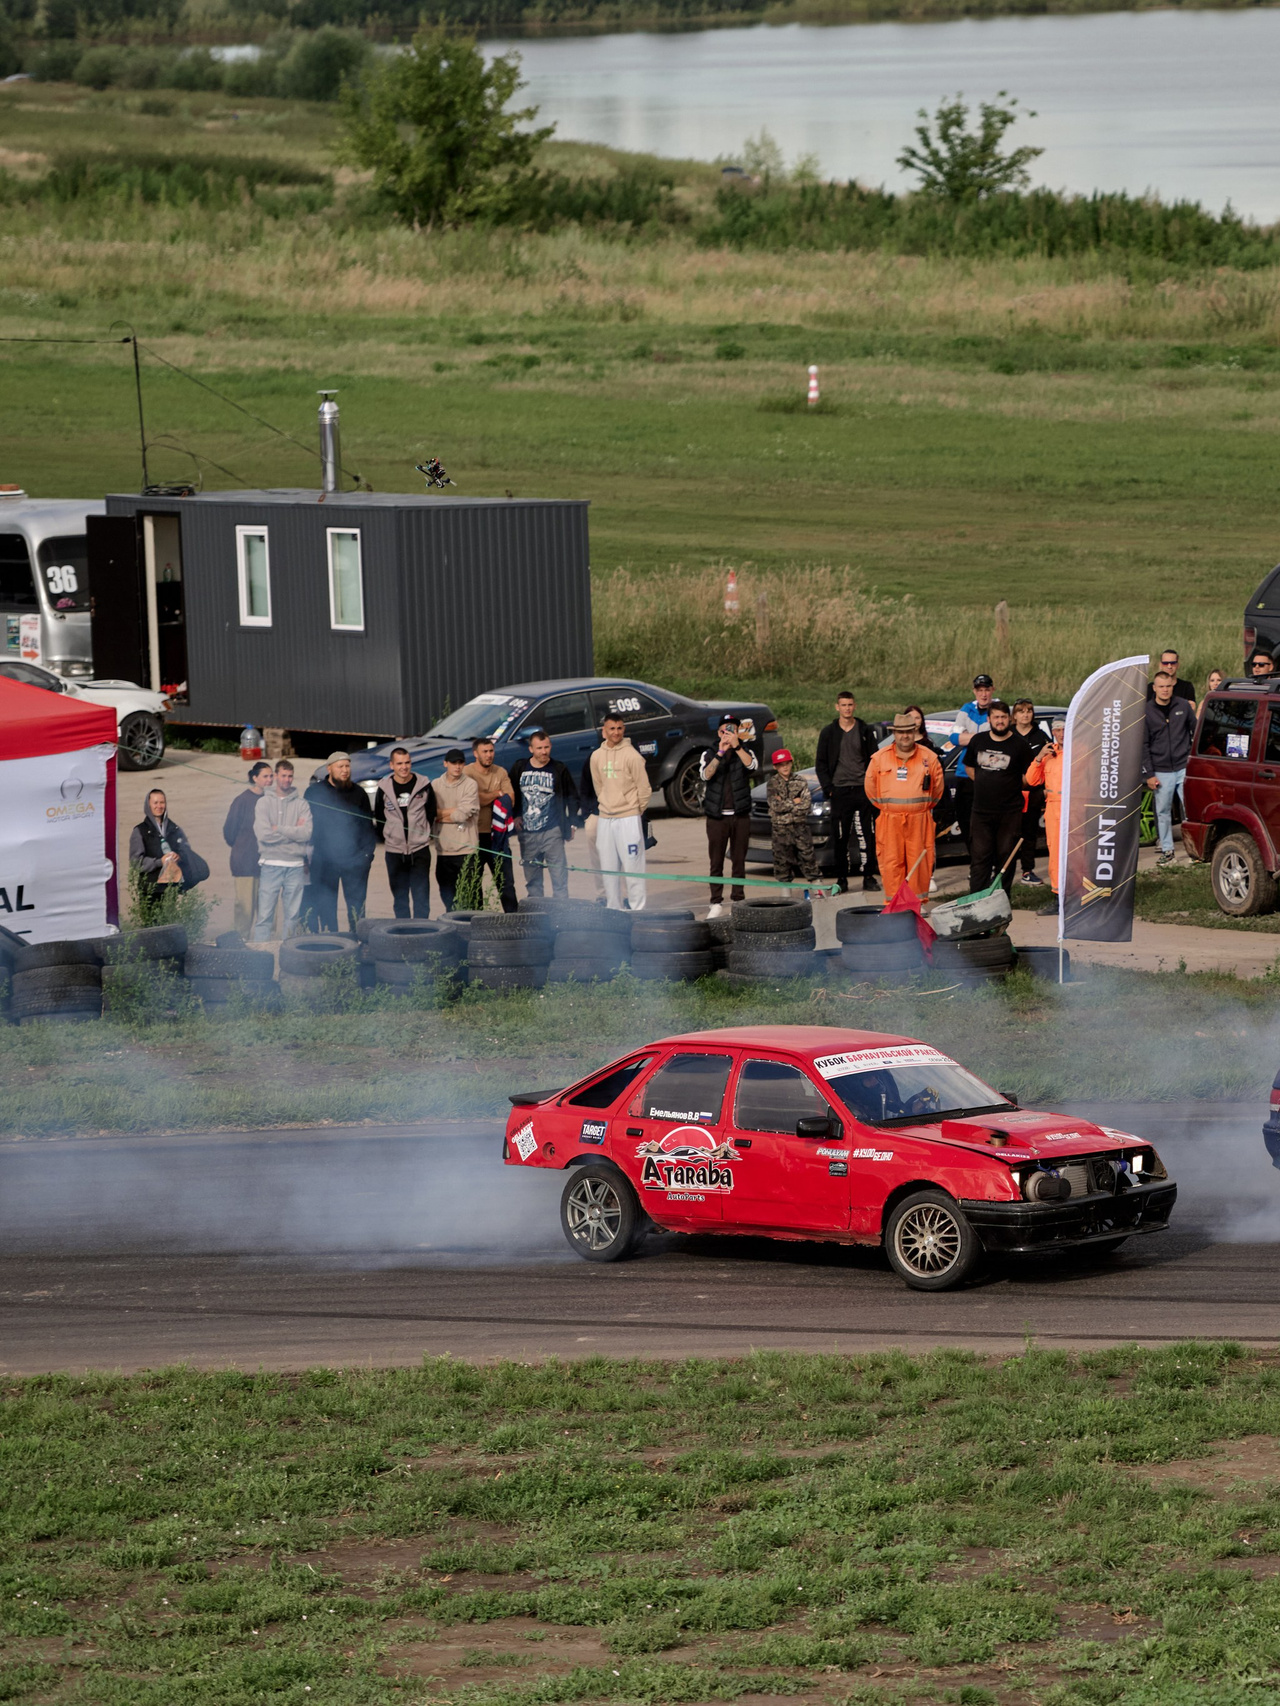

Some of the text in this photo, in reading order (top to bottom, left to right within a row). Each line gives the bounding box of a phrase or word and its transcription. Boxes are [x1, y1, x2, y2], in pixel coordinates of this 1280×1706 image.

[46, 565, 78, 594] 36
[616, 697, 641, 712] 096
[1099, 707, 1112, 799] СОВРЕМЕННАЯ
[1109, 699, 1122, 799] СТОМАТОЛОГИЯ
[46, 802, 96, 818] OMEGA
[46, 811, 95, 824] MOTOR SPORT
[815, 1055, 847, 1069] КУБОК
[845, 1048, 914, 1063] БАРНАУЛЬСКОЙ
[649, 1107, 687, 1119] Емельянов
[582, 1124, 606, 1136] TARGET
[667, 1191, 705, 1202] AutoParts
